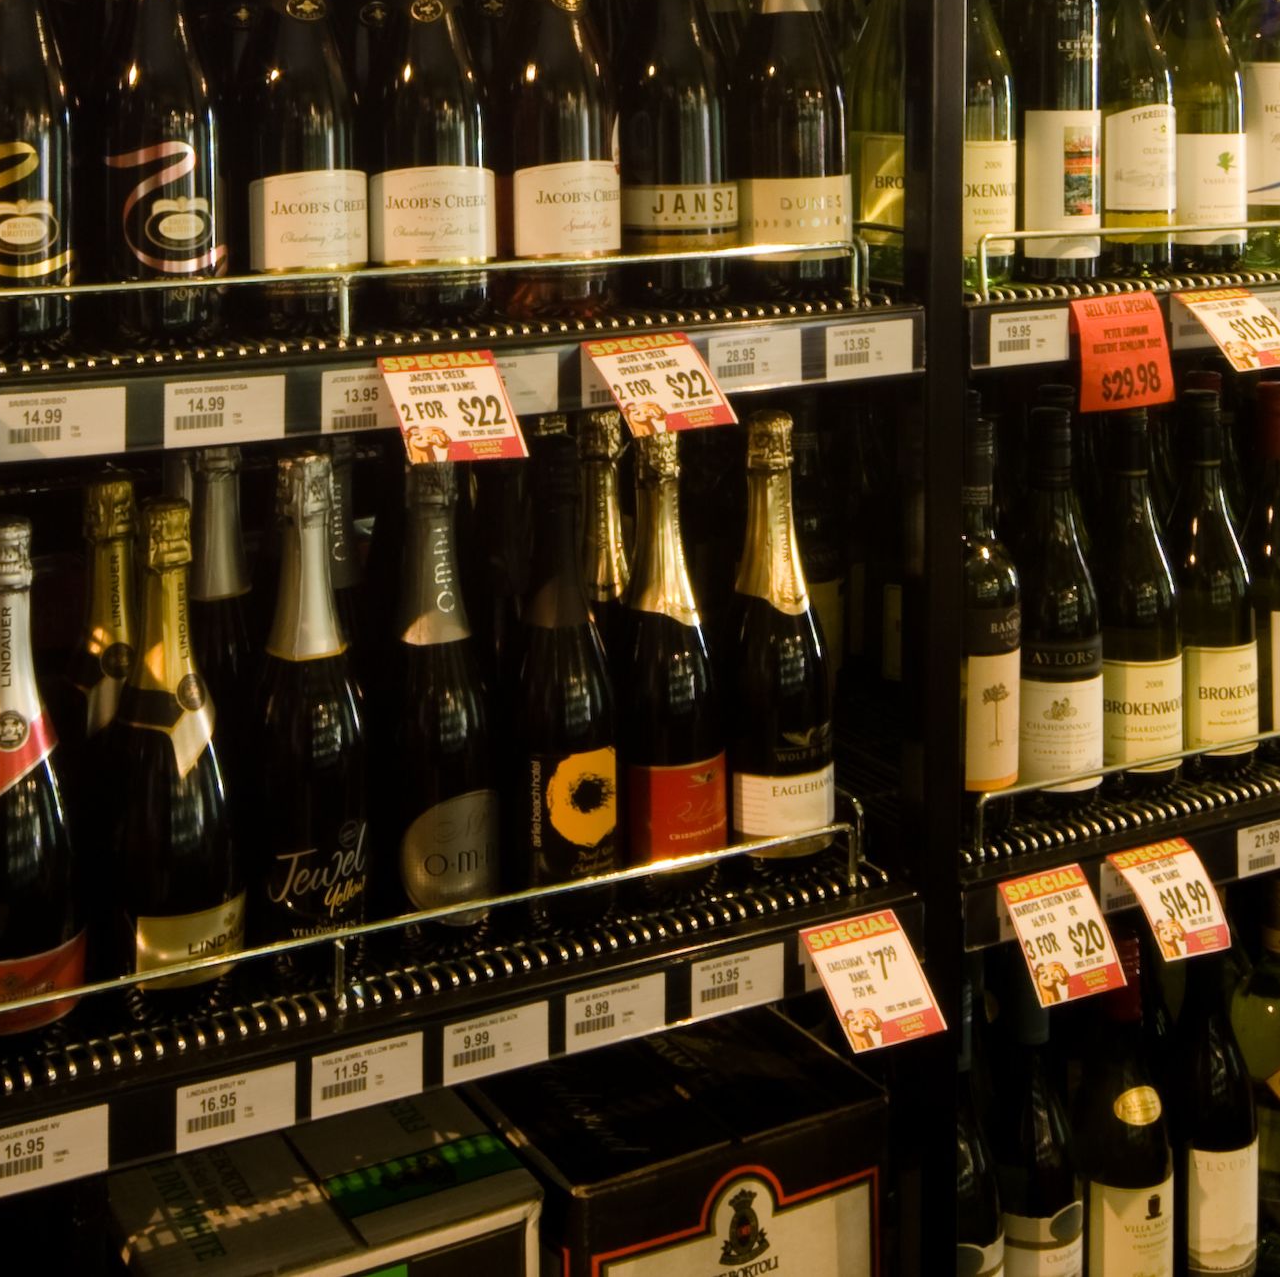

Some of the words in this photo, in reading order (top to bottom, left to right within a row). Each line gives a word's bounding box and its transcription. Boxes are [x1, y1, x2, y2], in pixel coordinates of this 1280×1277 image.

[385, 196, 441, 210] JACOB'S
[536, 190, 590, 204] JACOB'S
[652, 191, 734, 214] JANSZ
[780, 195, 842, 210] DUNES
[271, 201, 330, 215] JACOB'S
[1084, 303, 1104, 318] SELL
[1106, 302, 1122, 315] OUT
[1124, 299, 1156, 313] SPECIAL
[1006, 325, 1031, 338] 19.95
[588, 333, 687, 356] SPECIAL
[843, 337, 870, 351] 13.95
[383, 352, 490, 371] SPECIAL
[726, 348, 756, 363] 28.95
[613, 383, 626, 400] 2
[628, 378, 656, 397] FOR
[666, 369, 713, 400] $22
[1102, 361, 1161, 402] $29.98
[188, 397, 225, 412] 14.99
[344, 387, 379, 403] 13.95
[23, 409, 62, 425] 14.99
[401, 404, 413, 421] 2
[416, 400, 448, 420] FOR
[458, 394, 507, 427] $22
[0, 605, 12, 688] LINDAUER
[1255, 830, 1280, 848] 21.99
[268, 821, 366, 904] Jewel
[1114, 839, 1187, 867] SPECIAL
[1005, 869, 1082, 901] SPECIAL
[1160, 880, 1211, 920] $14.99
[808, 915, 894, 951] SPECIAL
[1068, 919, 1105, 958] $20
[1026, 940, 1037, 960] 3
[1036, 932, 1061, 957] FOR
[710, 968, 739, 986] 13.95
[585, 1000, 609, 1018] 8.99
[464, 1031, 490, 1049] 9.99
[334, 1061, 368, 1081] 11.95
[200, 1092, 237, 1113] 16.95
[4, 1137, 44, 1159] 16.95
[1124, 1224, 1151, 1234] VILLA
